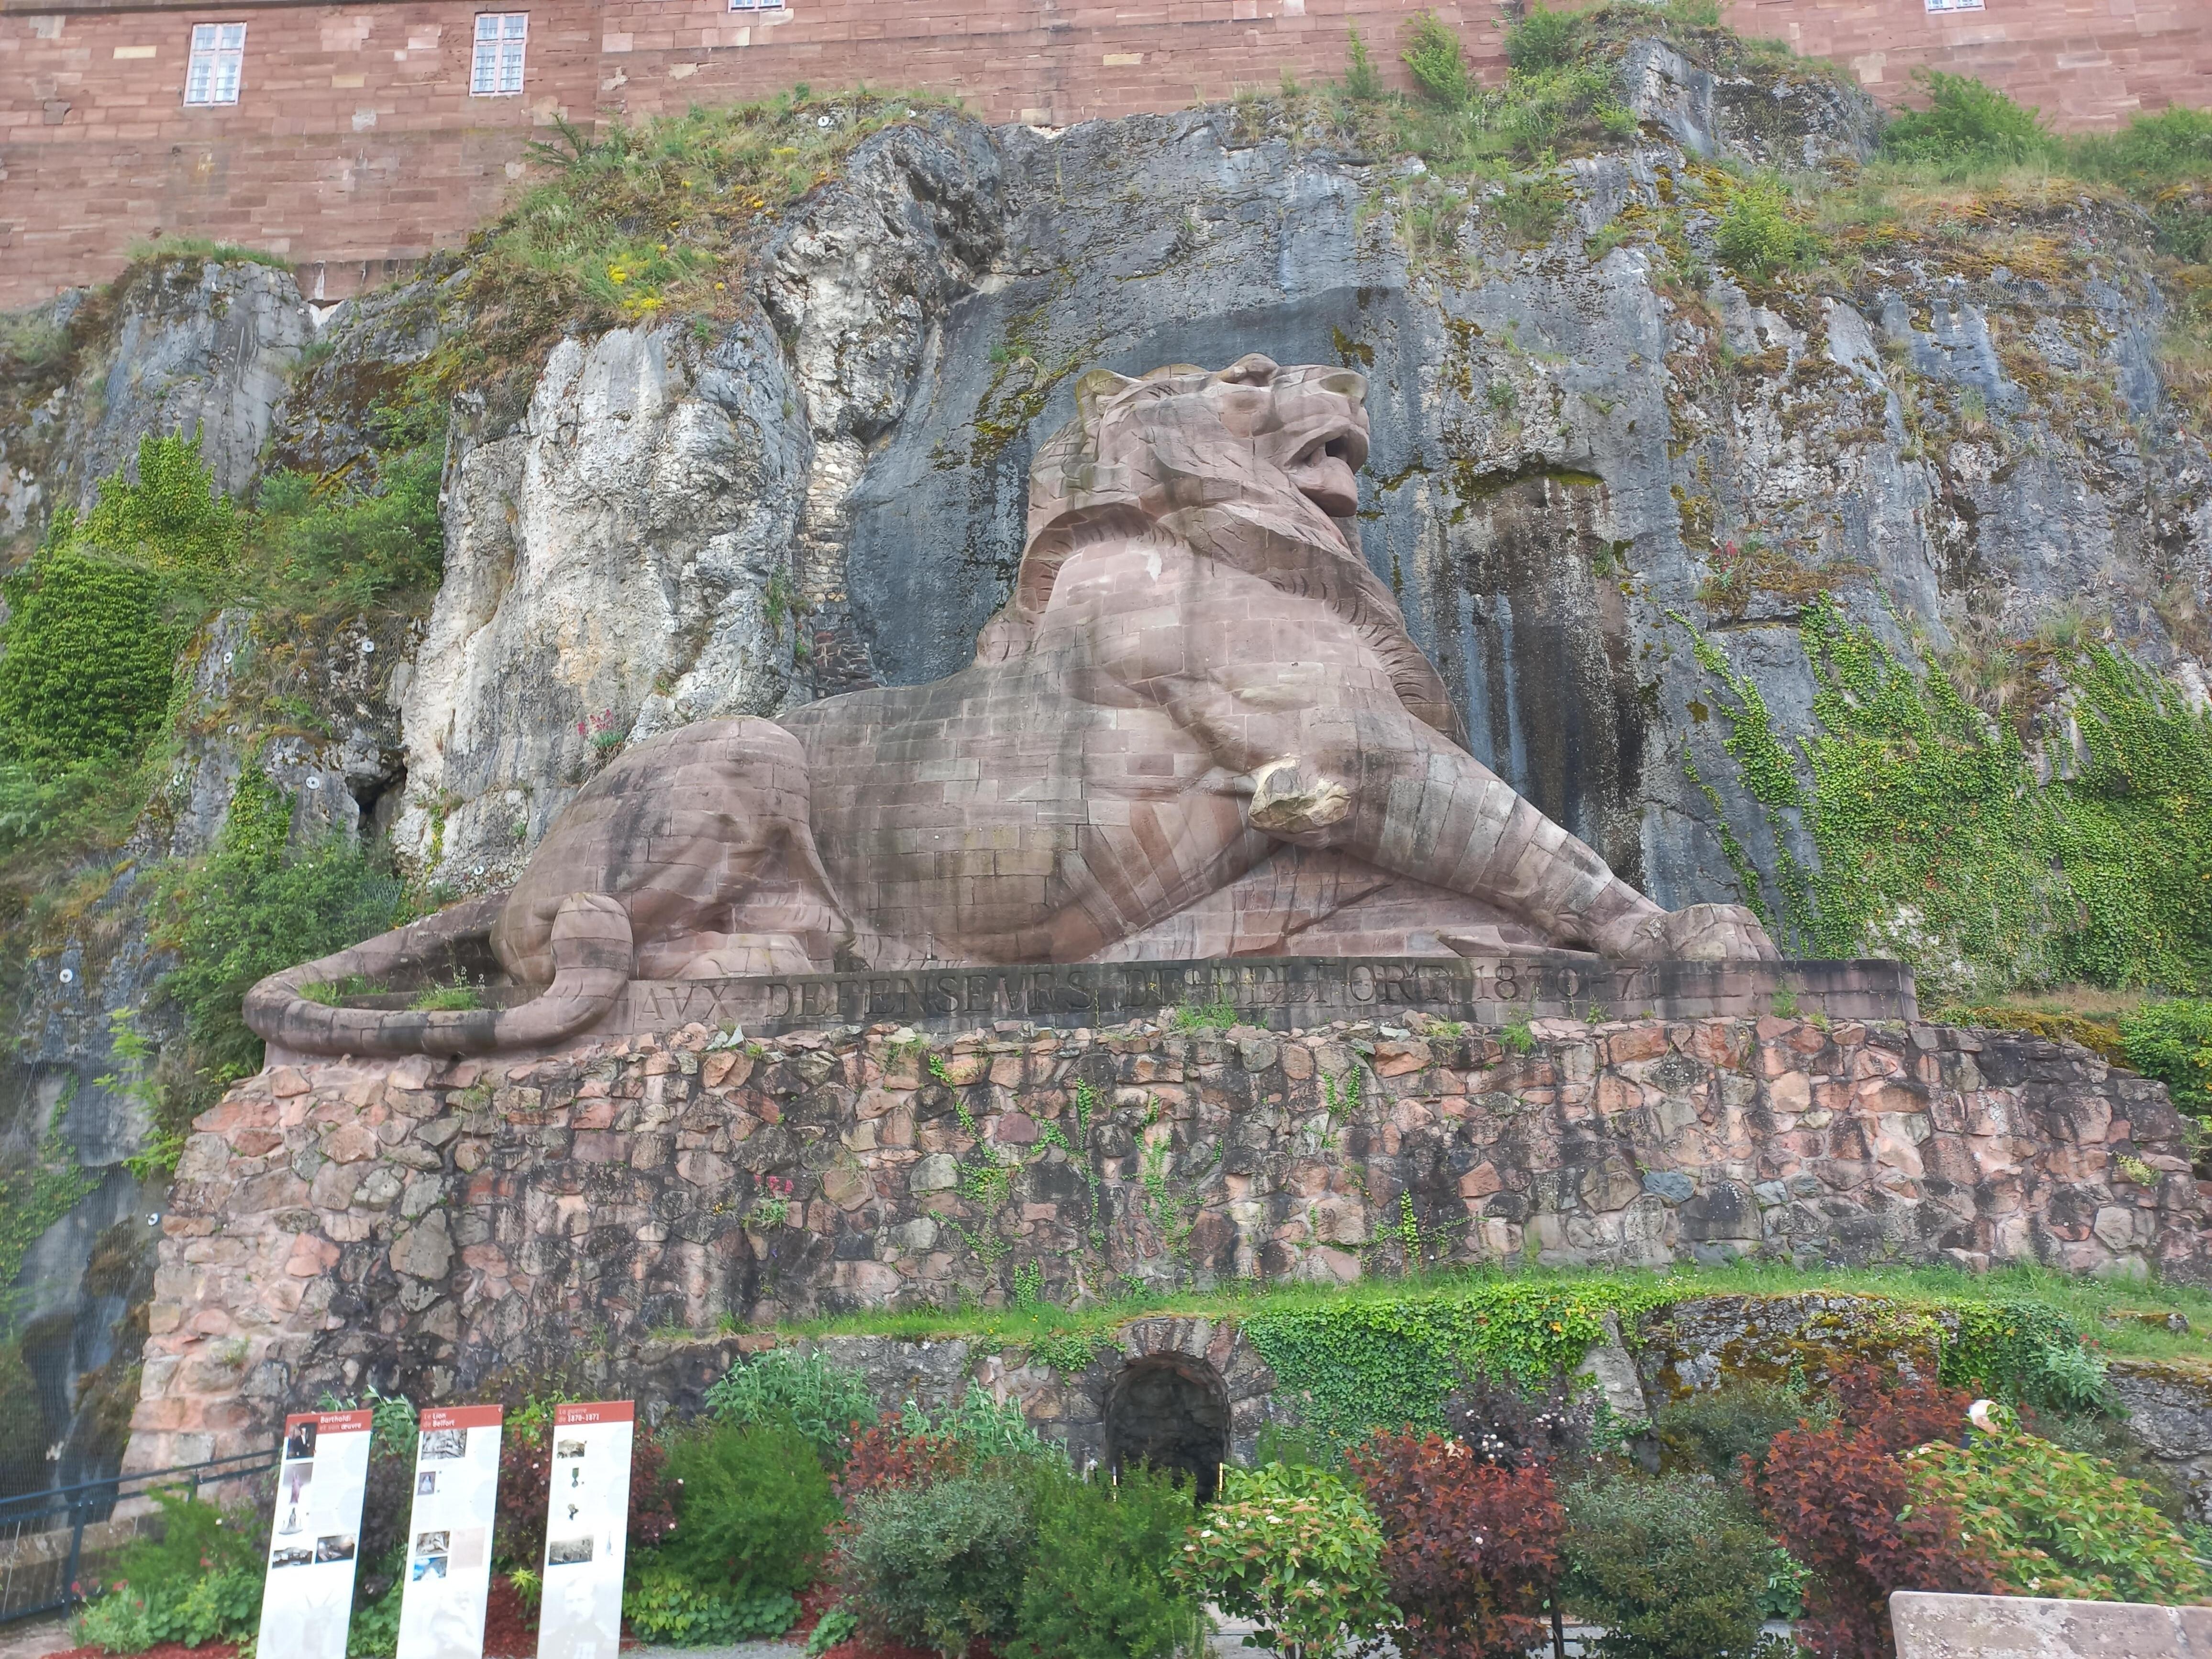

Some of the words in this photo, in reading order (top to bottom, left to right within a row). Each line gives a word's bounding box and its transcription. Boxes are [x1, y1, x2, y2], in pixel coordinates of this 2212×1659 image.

[320, 1414, 352, 1424] Bartholdi
[432, 1419, 455, 1427] Belfort
[567, 1413, 599, 1423] 1870-1871
